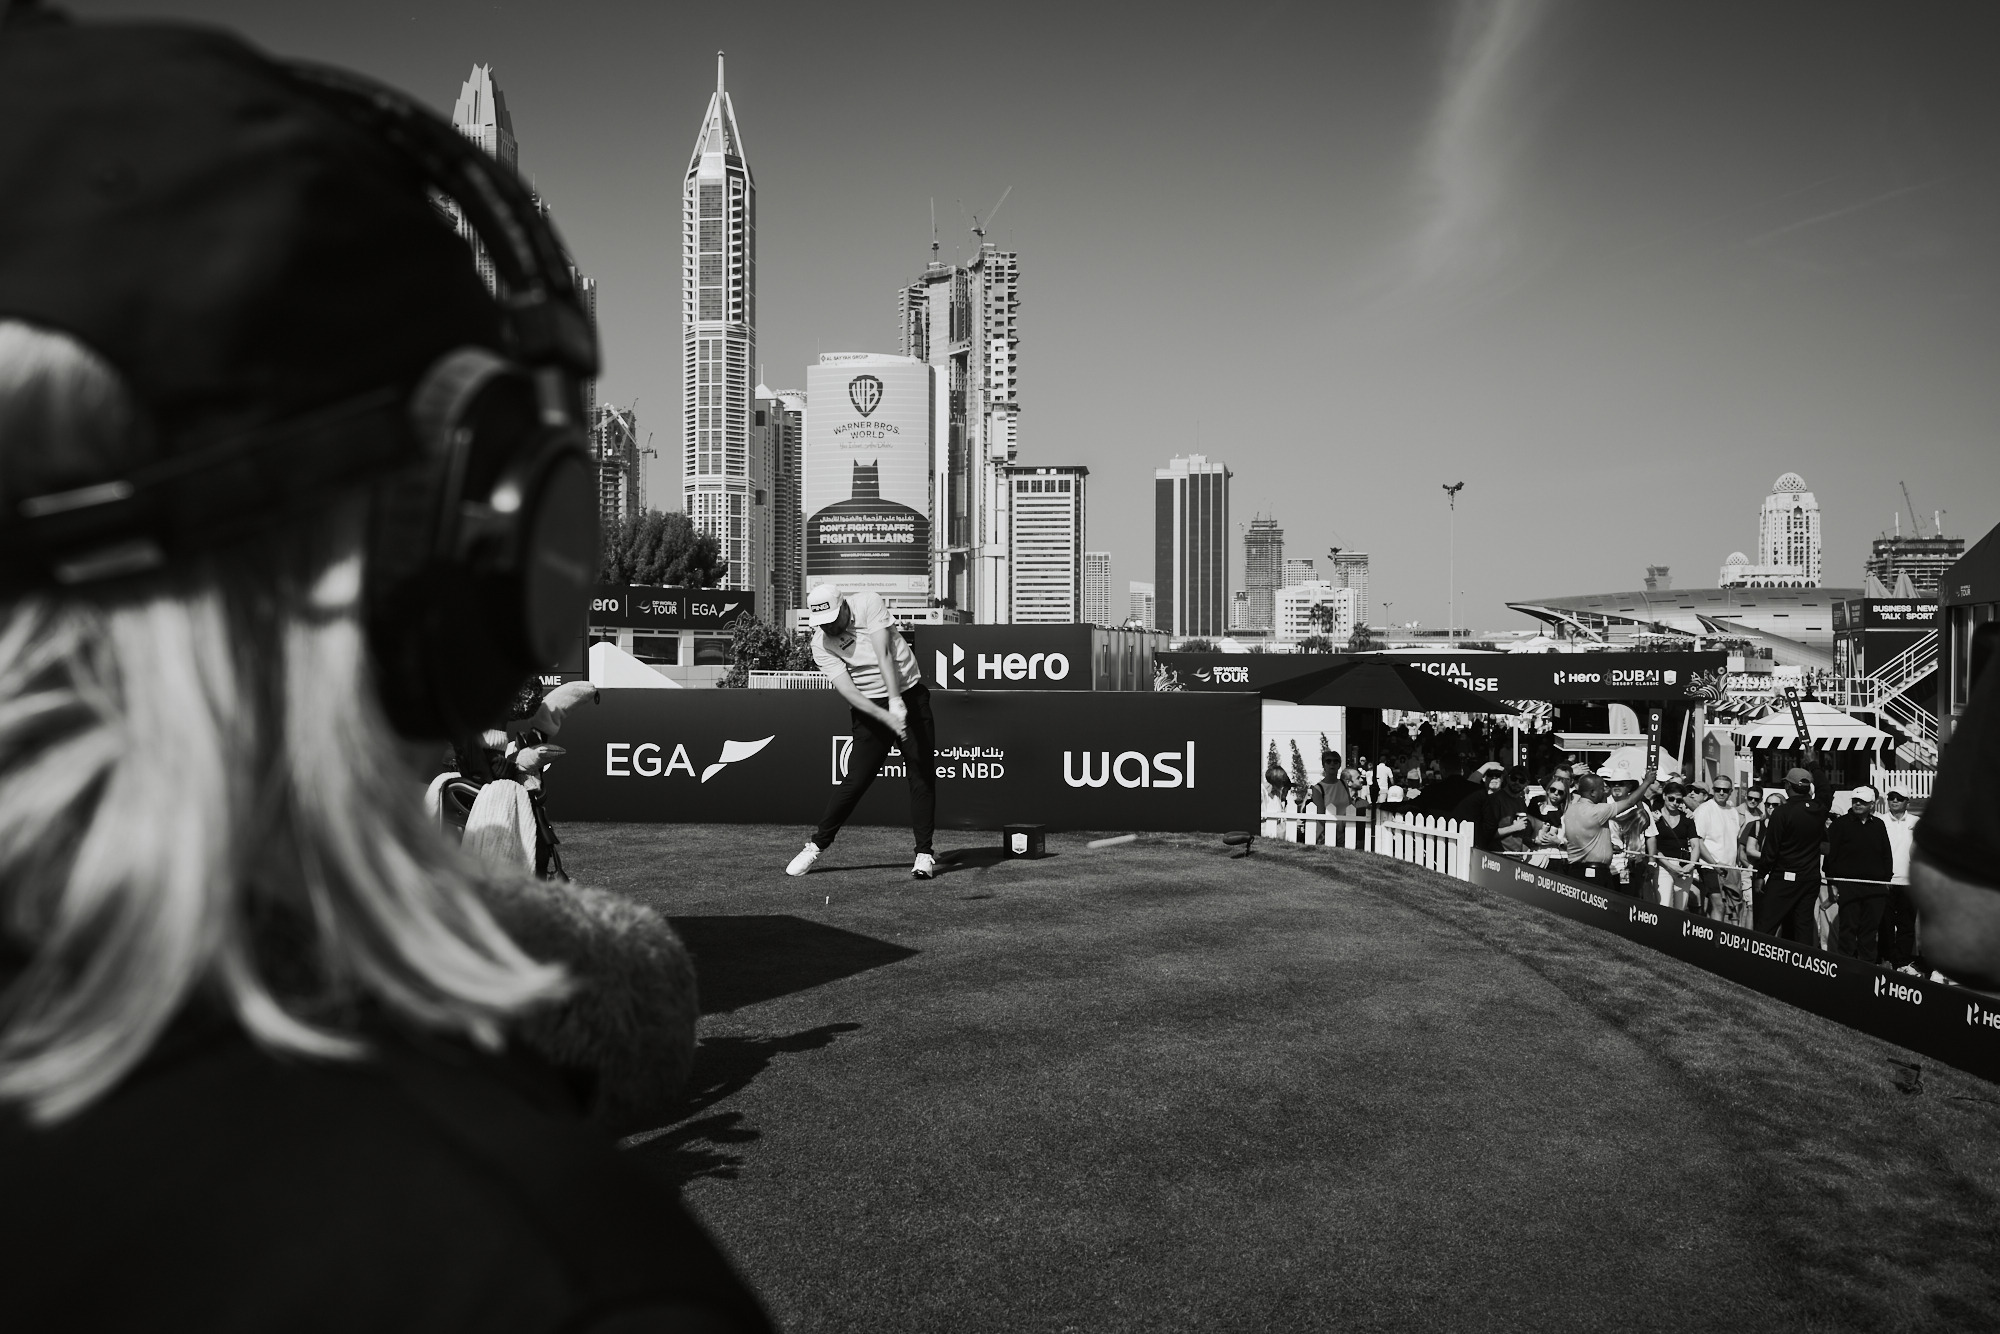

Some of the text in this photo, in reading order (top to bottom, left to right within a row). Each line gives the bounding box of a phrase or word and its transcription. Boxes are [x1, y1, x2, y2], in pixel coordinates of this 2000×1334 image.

[833, 421, 900, 435] WARNER BROS.
[850, 430, 885, 439] WORLD
[847, 523, 874, 532] FIGHT
[875, 523, 915, 532] TRAFFIC
[819, 532, 915, 544] FIGHT VILLAINS
[590, 598, 619, 612] ero
[652, 605, 678, 615] TOUR
[691, 603, 718, 616] EGA
[1872, 604, 1912, 612] BUSINESS
[1880, 612, 1935, 620] TALK SPORT
[977, 653, 1070, 681] Hero
[1213, 672, 1250, 684] TOUR
[1568, 673, 1601, 683] Hero
[1612, 669, 1660, 682] DUBAI
[1787, 691, 1806, 737] QUIET
[1650, 713, 1660, 763] QUIET
[606, 742, 697, 777] EGA
[1063, 740, 1195, 789] wasl
[962, 762, 1005, 779] NBD
[1556, 882, 1582, 900] DESERT
[1580, 890, 1609, 910] CLASSIC
[1637, 910, 1658, 926] Hero
[1691, 924, 1838, 978] Hero DUBAI DESERT CLASSIC
[1888, 982, 1923, 1005] Hero
[1982, 1010, 2000, 1030] He
